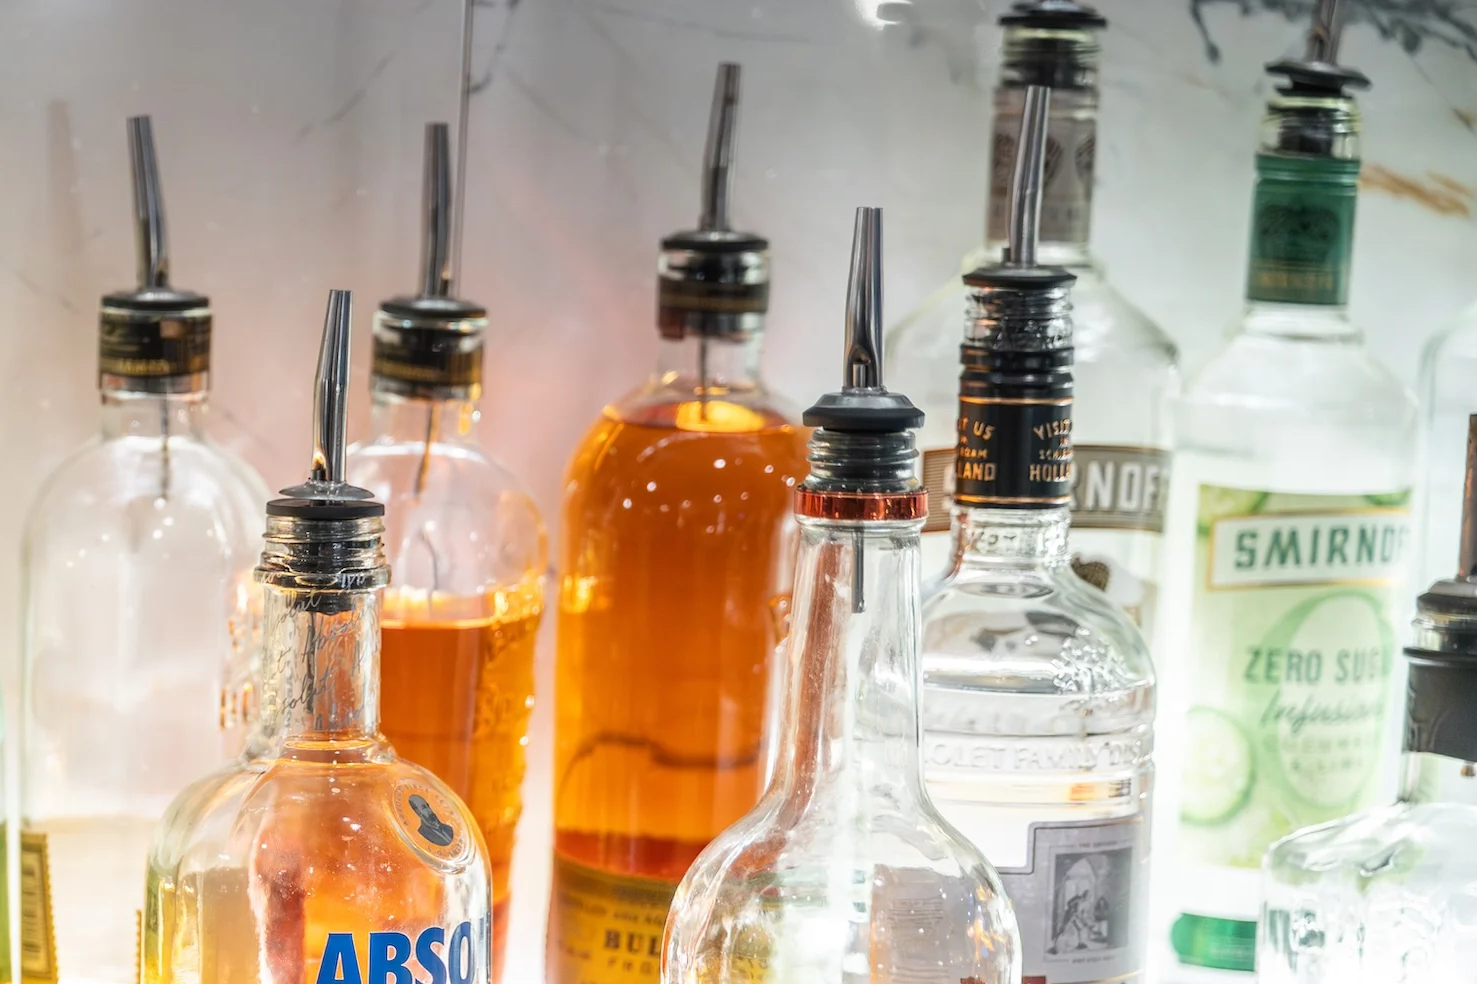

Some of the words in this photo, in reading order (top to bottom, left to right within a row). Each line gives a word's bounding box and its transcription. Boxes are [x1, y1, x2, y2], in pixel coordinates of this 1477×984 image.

[973, 421, 996, 440] US
[1033, 418, 1071, 440] VISIT
[1234, 519, 1402, 571] SMIRN
[1243, 647, 1322, 685] ZERO
